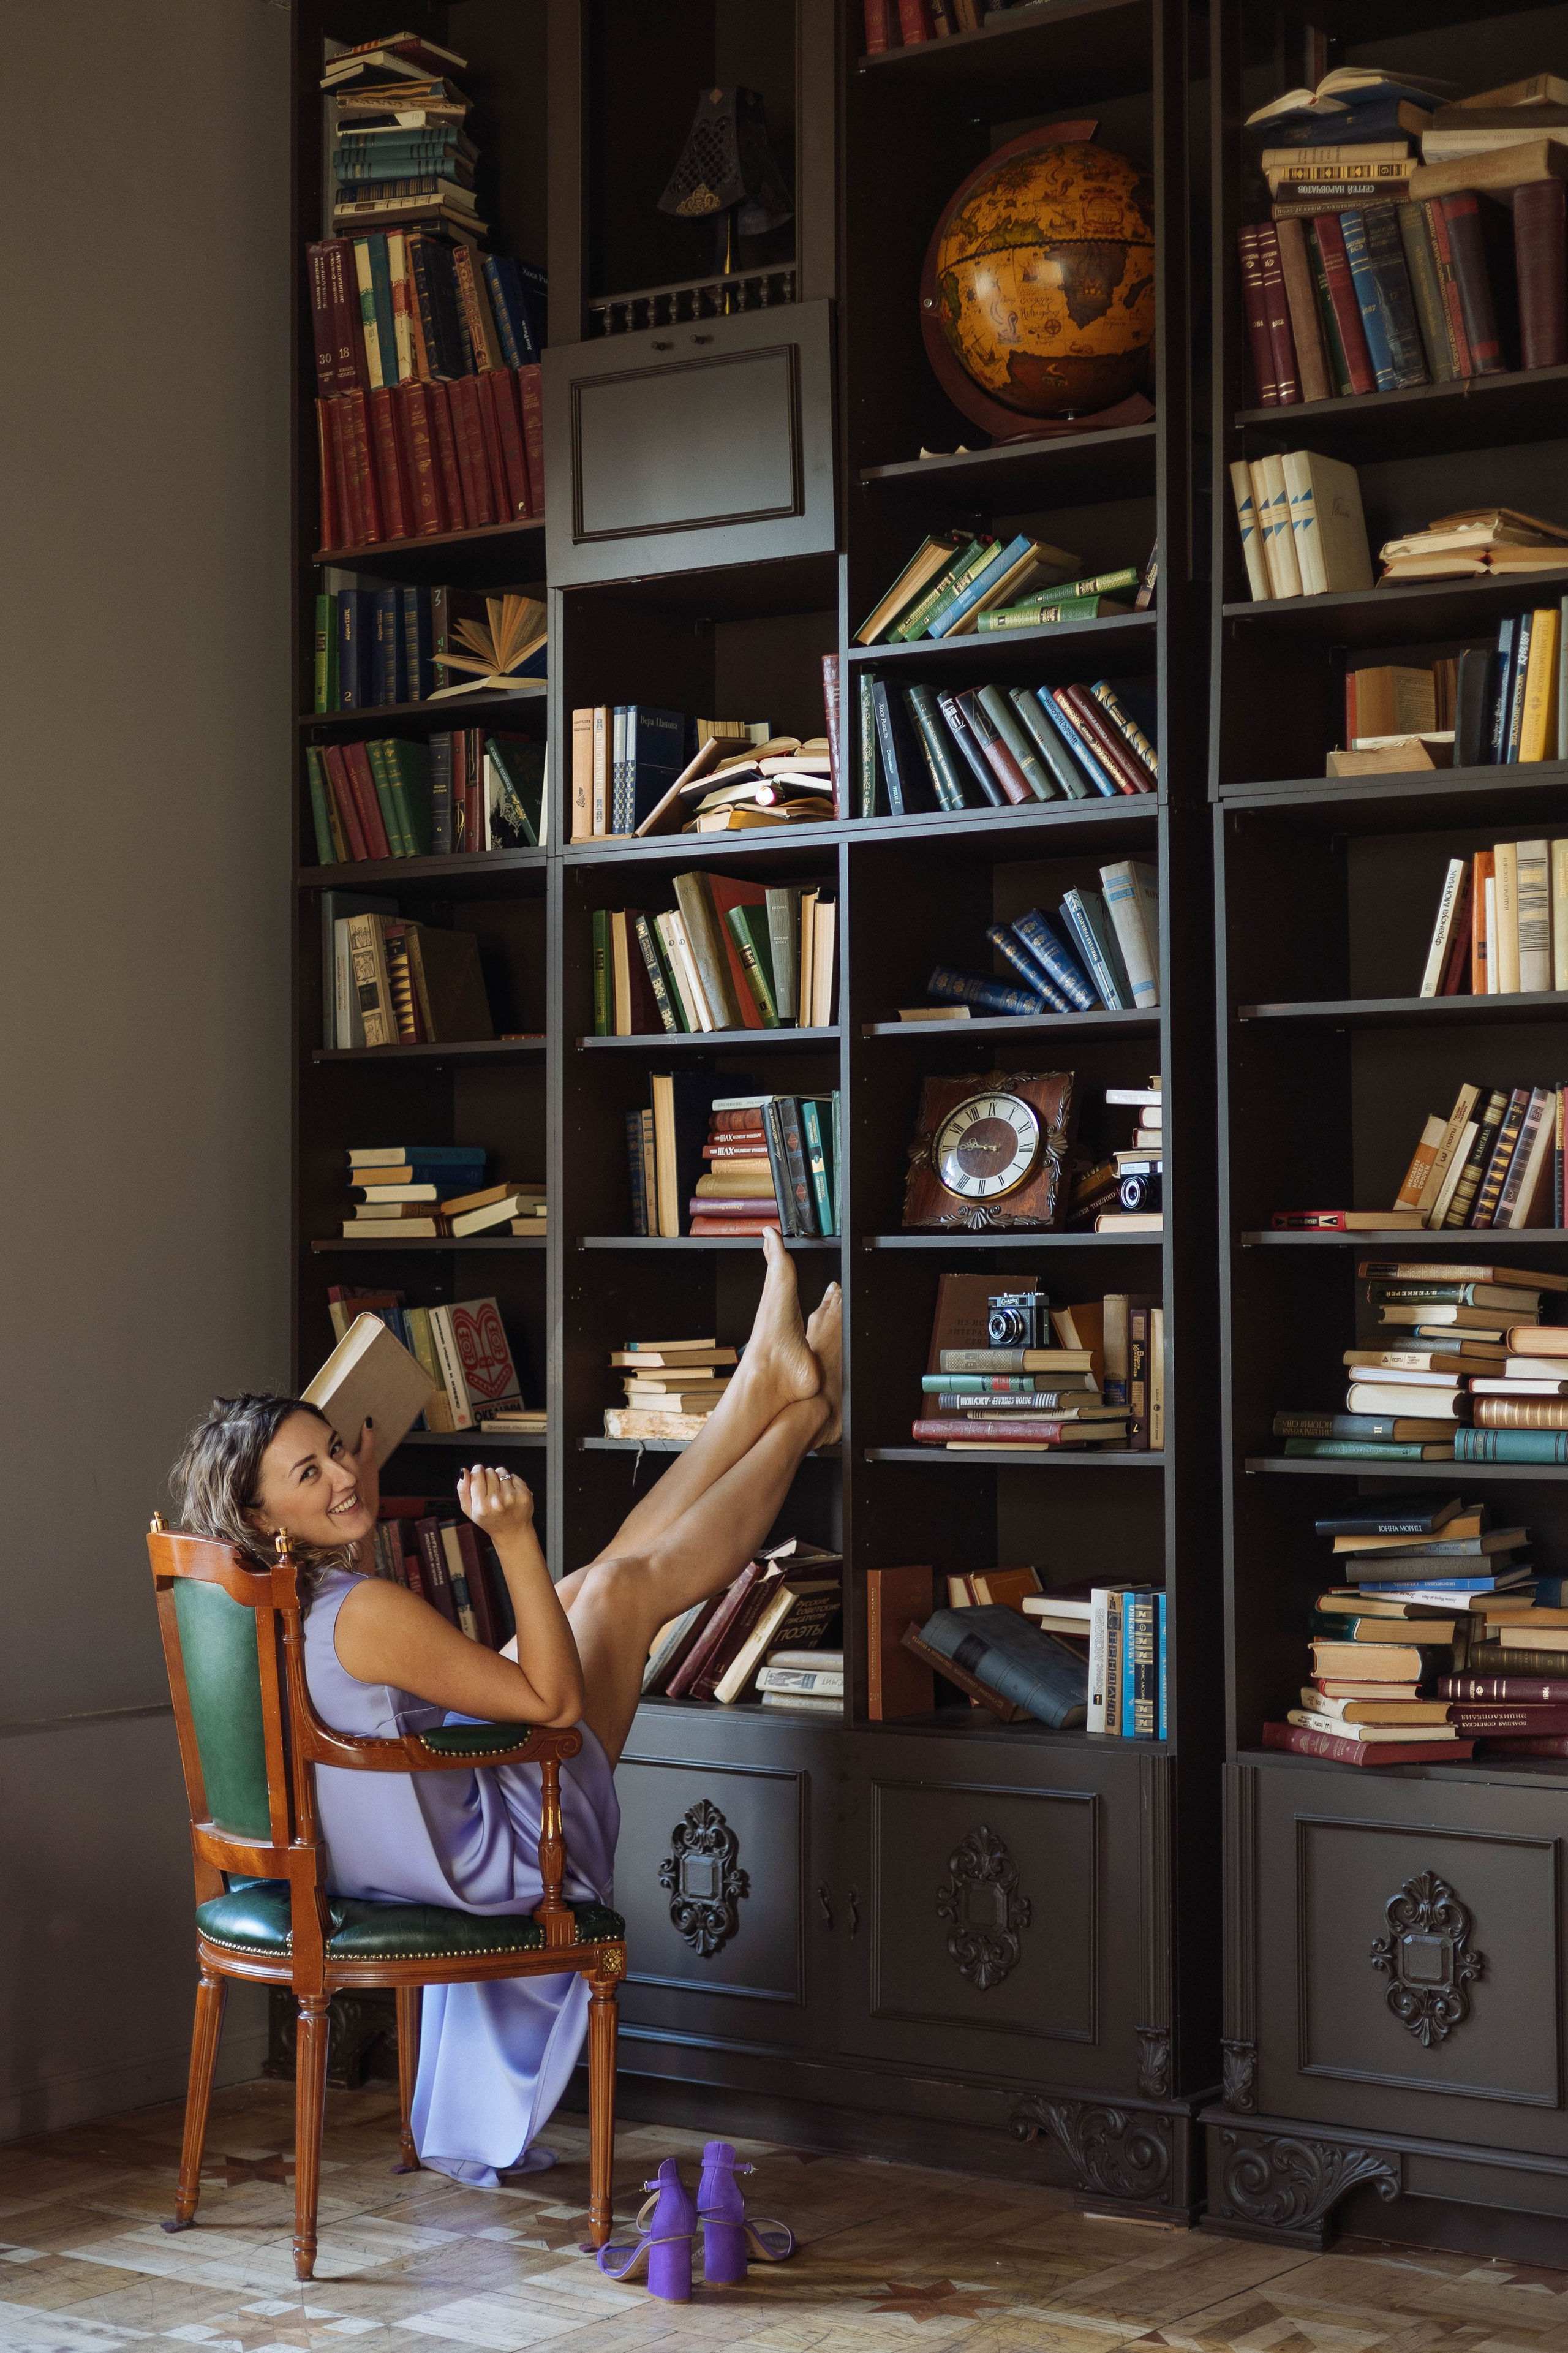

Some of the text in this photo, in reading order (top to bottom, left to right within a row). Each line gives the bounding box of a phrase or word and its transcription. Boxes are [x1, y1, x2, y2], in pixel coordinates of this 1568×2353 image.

[1298, 184, 1374, 194] СЕРГЕЙ НАРОВЧАТОВ
[1349, 244, 1363, 254] БСЭ
[1271, 318, 1284, 328] 1982
[318, 353, 331, 365] 30
[339, 346, 350, 359] 18
[433, 588, 442, 608] 3
[1518, 632, 1530, 665] КРЫЛЬЯ
[344, 690, 352, 702] 2
[1511, 674, 1524, 746] ВЛАДИМИР СОСЮРА
[640, 715, 677, 730] Вера Панова
[1435, 869, 1457, 946] Франсуа МОРИАК
[1075, 911, 1099, 961] НИКОЛАЙ ГРИБАЧЕВ
[966, 1106, 980, 1122] VIII
[988, 1102, 998, 1116] IX
[1006, 1107, 1018, 1121] X
[767, 1108, 780, 1143] ФЕЙХТВАНГЕР
[949, 1123, 964, 1135] VII
[1446, 1128, 1458, 1149] ПОЭТЫ
[1474, 1128, 1491, 1163] М.ЛАССИЛА
[1440, 1152, 1449, 1162] 3
[1407, 1158, 1421, 1189] МЕНДЕЛЕ
[1417, 1165, 1431, 1190] СФОРИМ
[1507, 1190, 1514, 1200] 3
[960, 1396, 989, 1407] ДЖУНГЛИ
[1133, 1424, 1139, 1433] 7
[1283, 1428, 1332, 1437] ЛИТЕРАТУРНАЯ
[428, 1531, 446, 1585] ЭНЦИКЛОПЕДИЯ
[796, 1603, 841, 1615] советские
[797, 1599, 830, 1607] Русские
[785, 1613, 826, 1625] писатели
[774, 1623, 829, 1643] ПОЭТЫ
[1095, 1608, 1105, 1695] Борис МОЖАЕВ
[1107, 1611, 1122, 1726] СТЕНДАЛЬ
